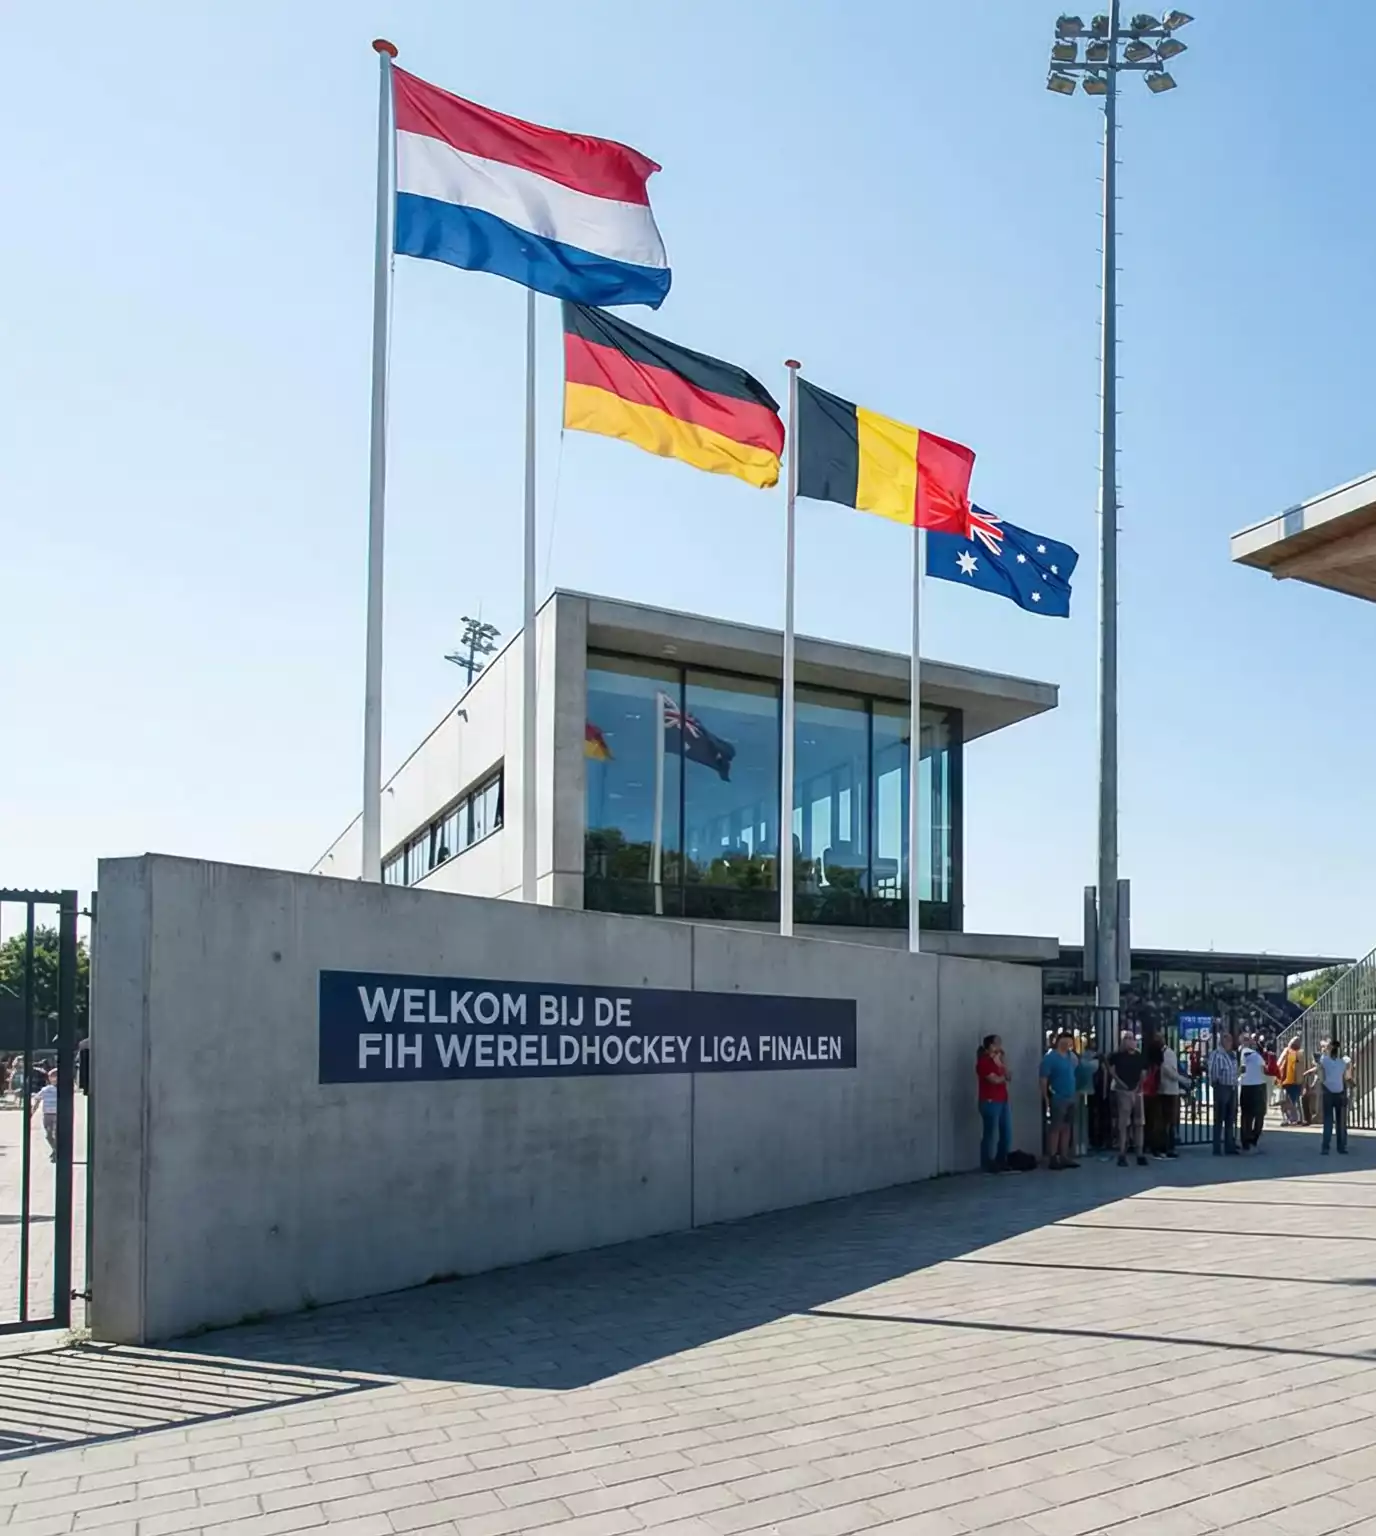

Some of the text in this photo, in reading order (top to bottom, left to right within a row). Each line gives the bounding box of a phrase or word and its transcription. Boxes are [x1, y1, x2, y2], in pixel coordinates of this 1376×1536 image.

[357, 986, 632, 1027] WELKOM BIJ DE
[359, 1033, 842, 1069] FIH WERELDHOCKEY LIGA FINALEN
